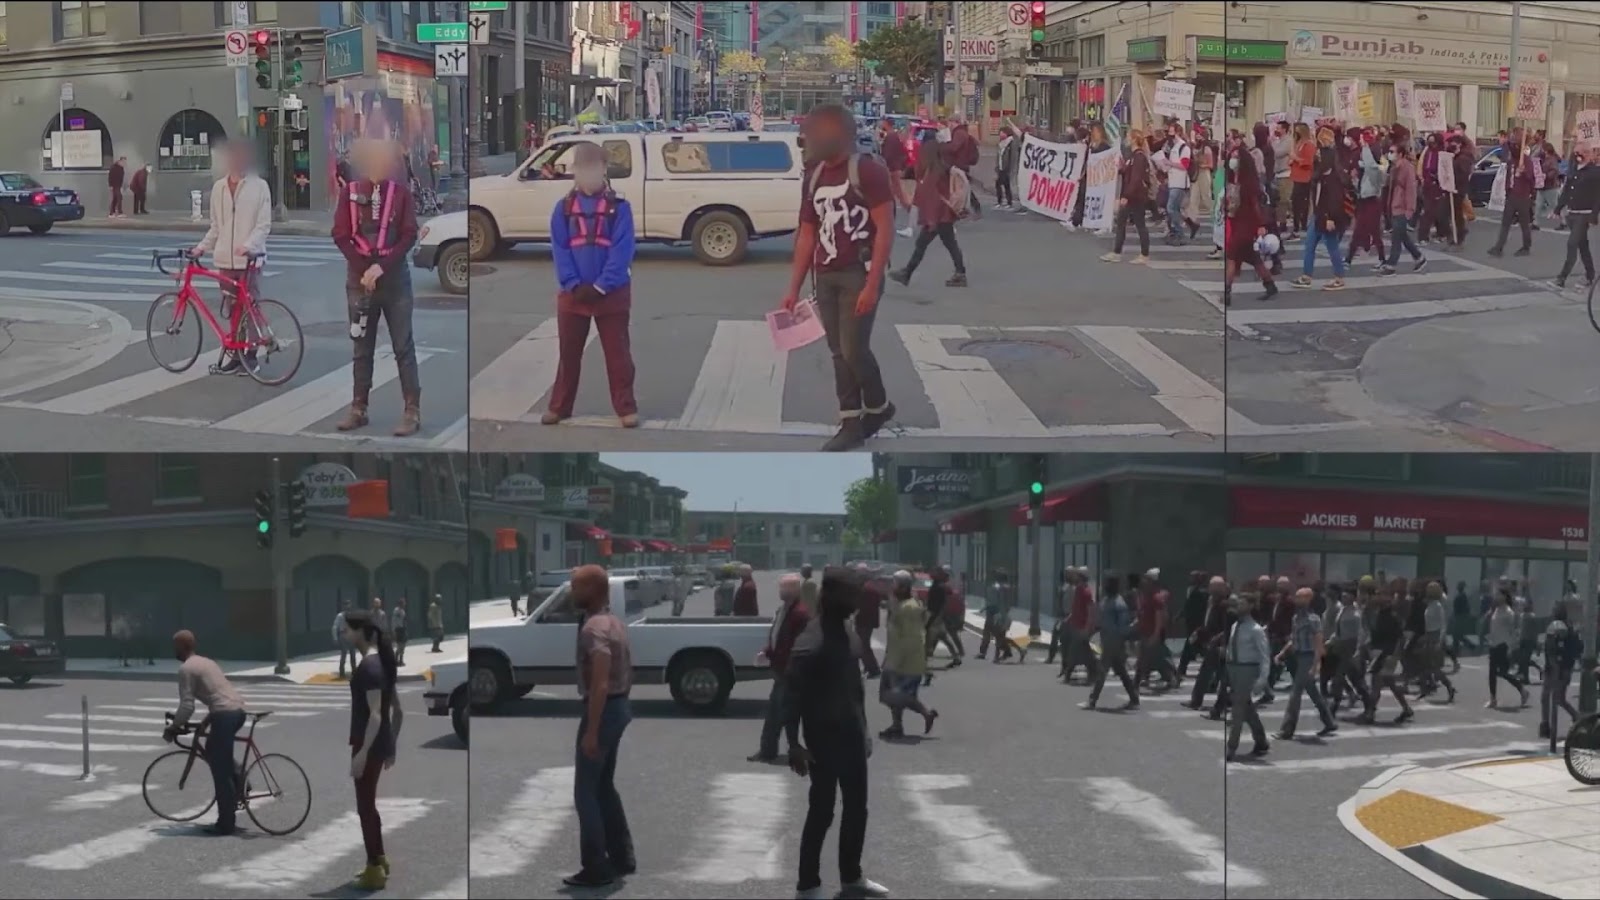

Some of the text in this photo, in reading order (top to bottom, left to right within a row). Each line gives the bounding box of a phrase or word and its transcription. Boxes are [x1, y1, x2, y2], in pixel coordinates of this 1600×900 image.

[435, 28, 467, 39] Eddy
[1321, 34, 1425, 56] Punjab
[1430, 48, 1464, 58] Indian
[1480, 53, 1533, 62] Pakisni
[1024, 143, 1057, 174] SHUT
[1060, 151, 1077, 179] IT
[1028, 173, 1075, 213] DOWN!
[306, 471, 346, 484] Toby's
[1302, 514, 1426, 530] JACKIES MARKET
